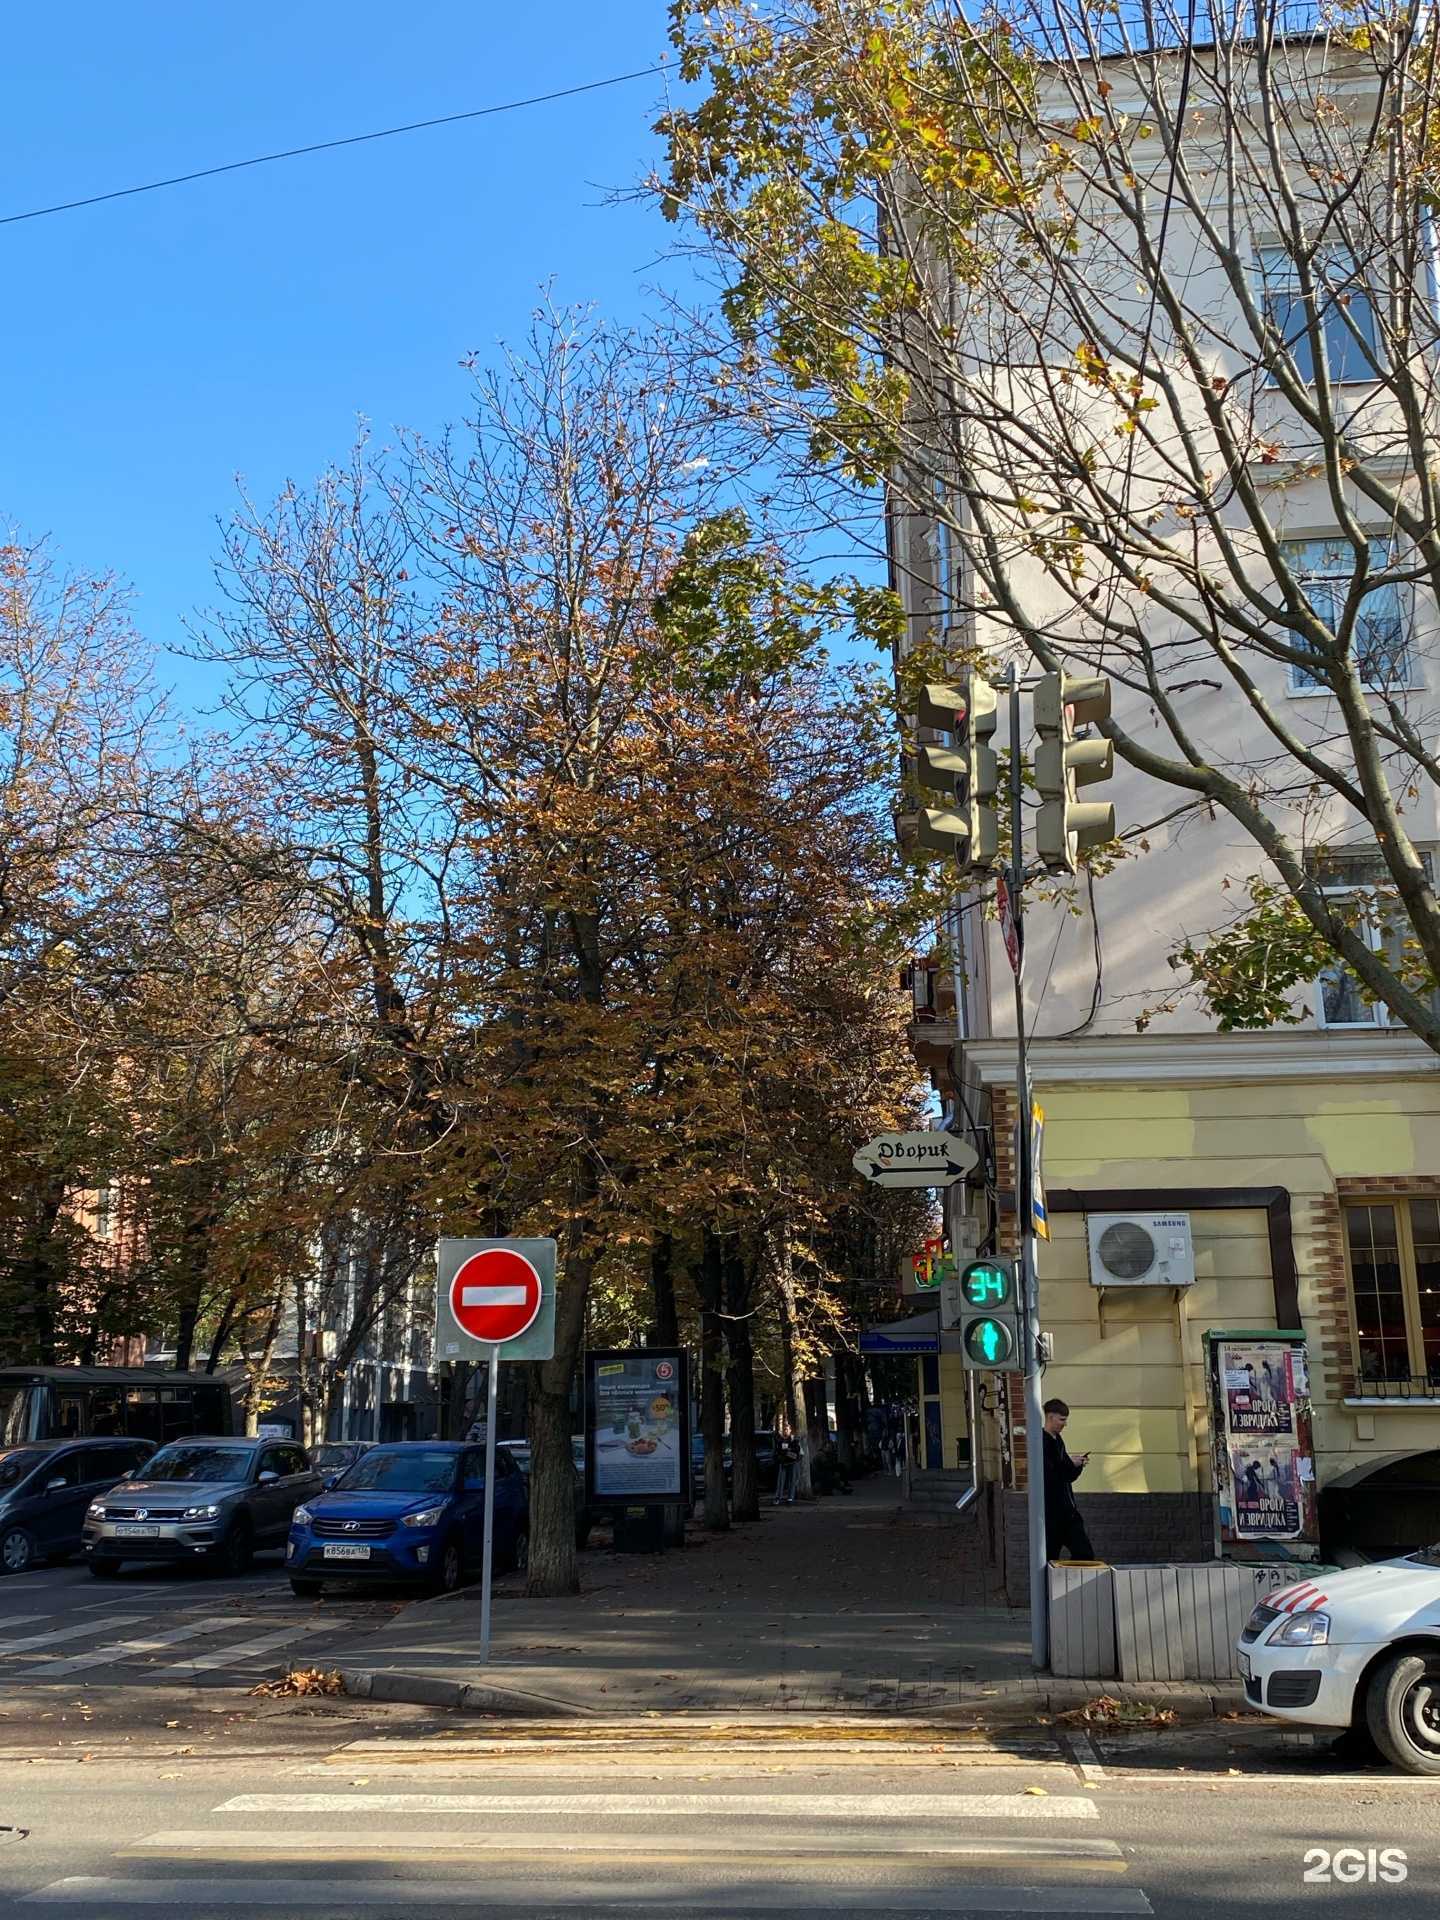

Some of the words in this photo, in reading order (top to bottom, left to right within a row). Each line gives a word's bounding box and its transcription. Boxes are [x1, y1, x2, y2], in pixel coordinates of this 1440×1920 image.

[878, 1141, 950, 1163] Дворик
[1152, 1220, 1186, 1228] SAMSUNG
[968, 1269, 1003, 1302] 34
[1239, 1512, 1245, 1526] И
[1247, 1512, 1286, 1528] ЭВРИДИКА
